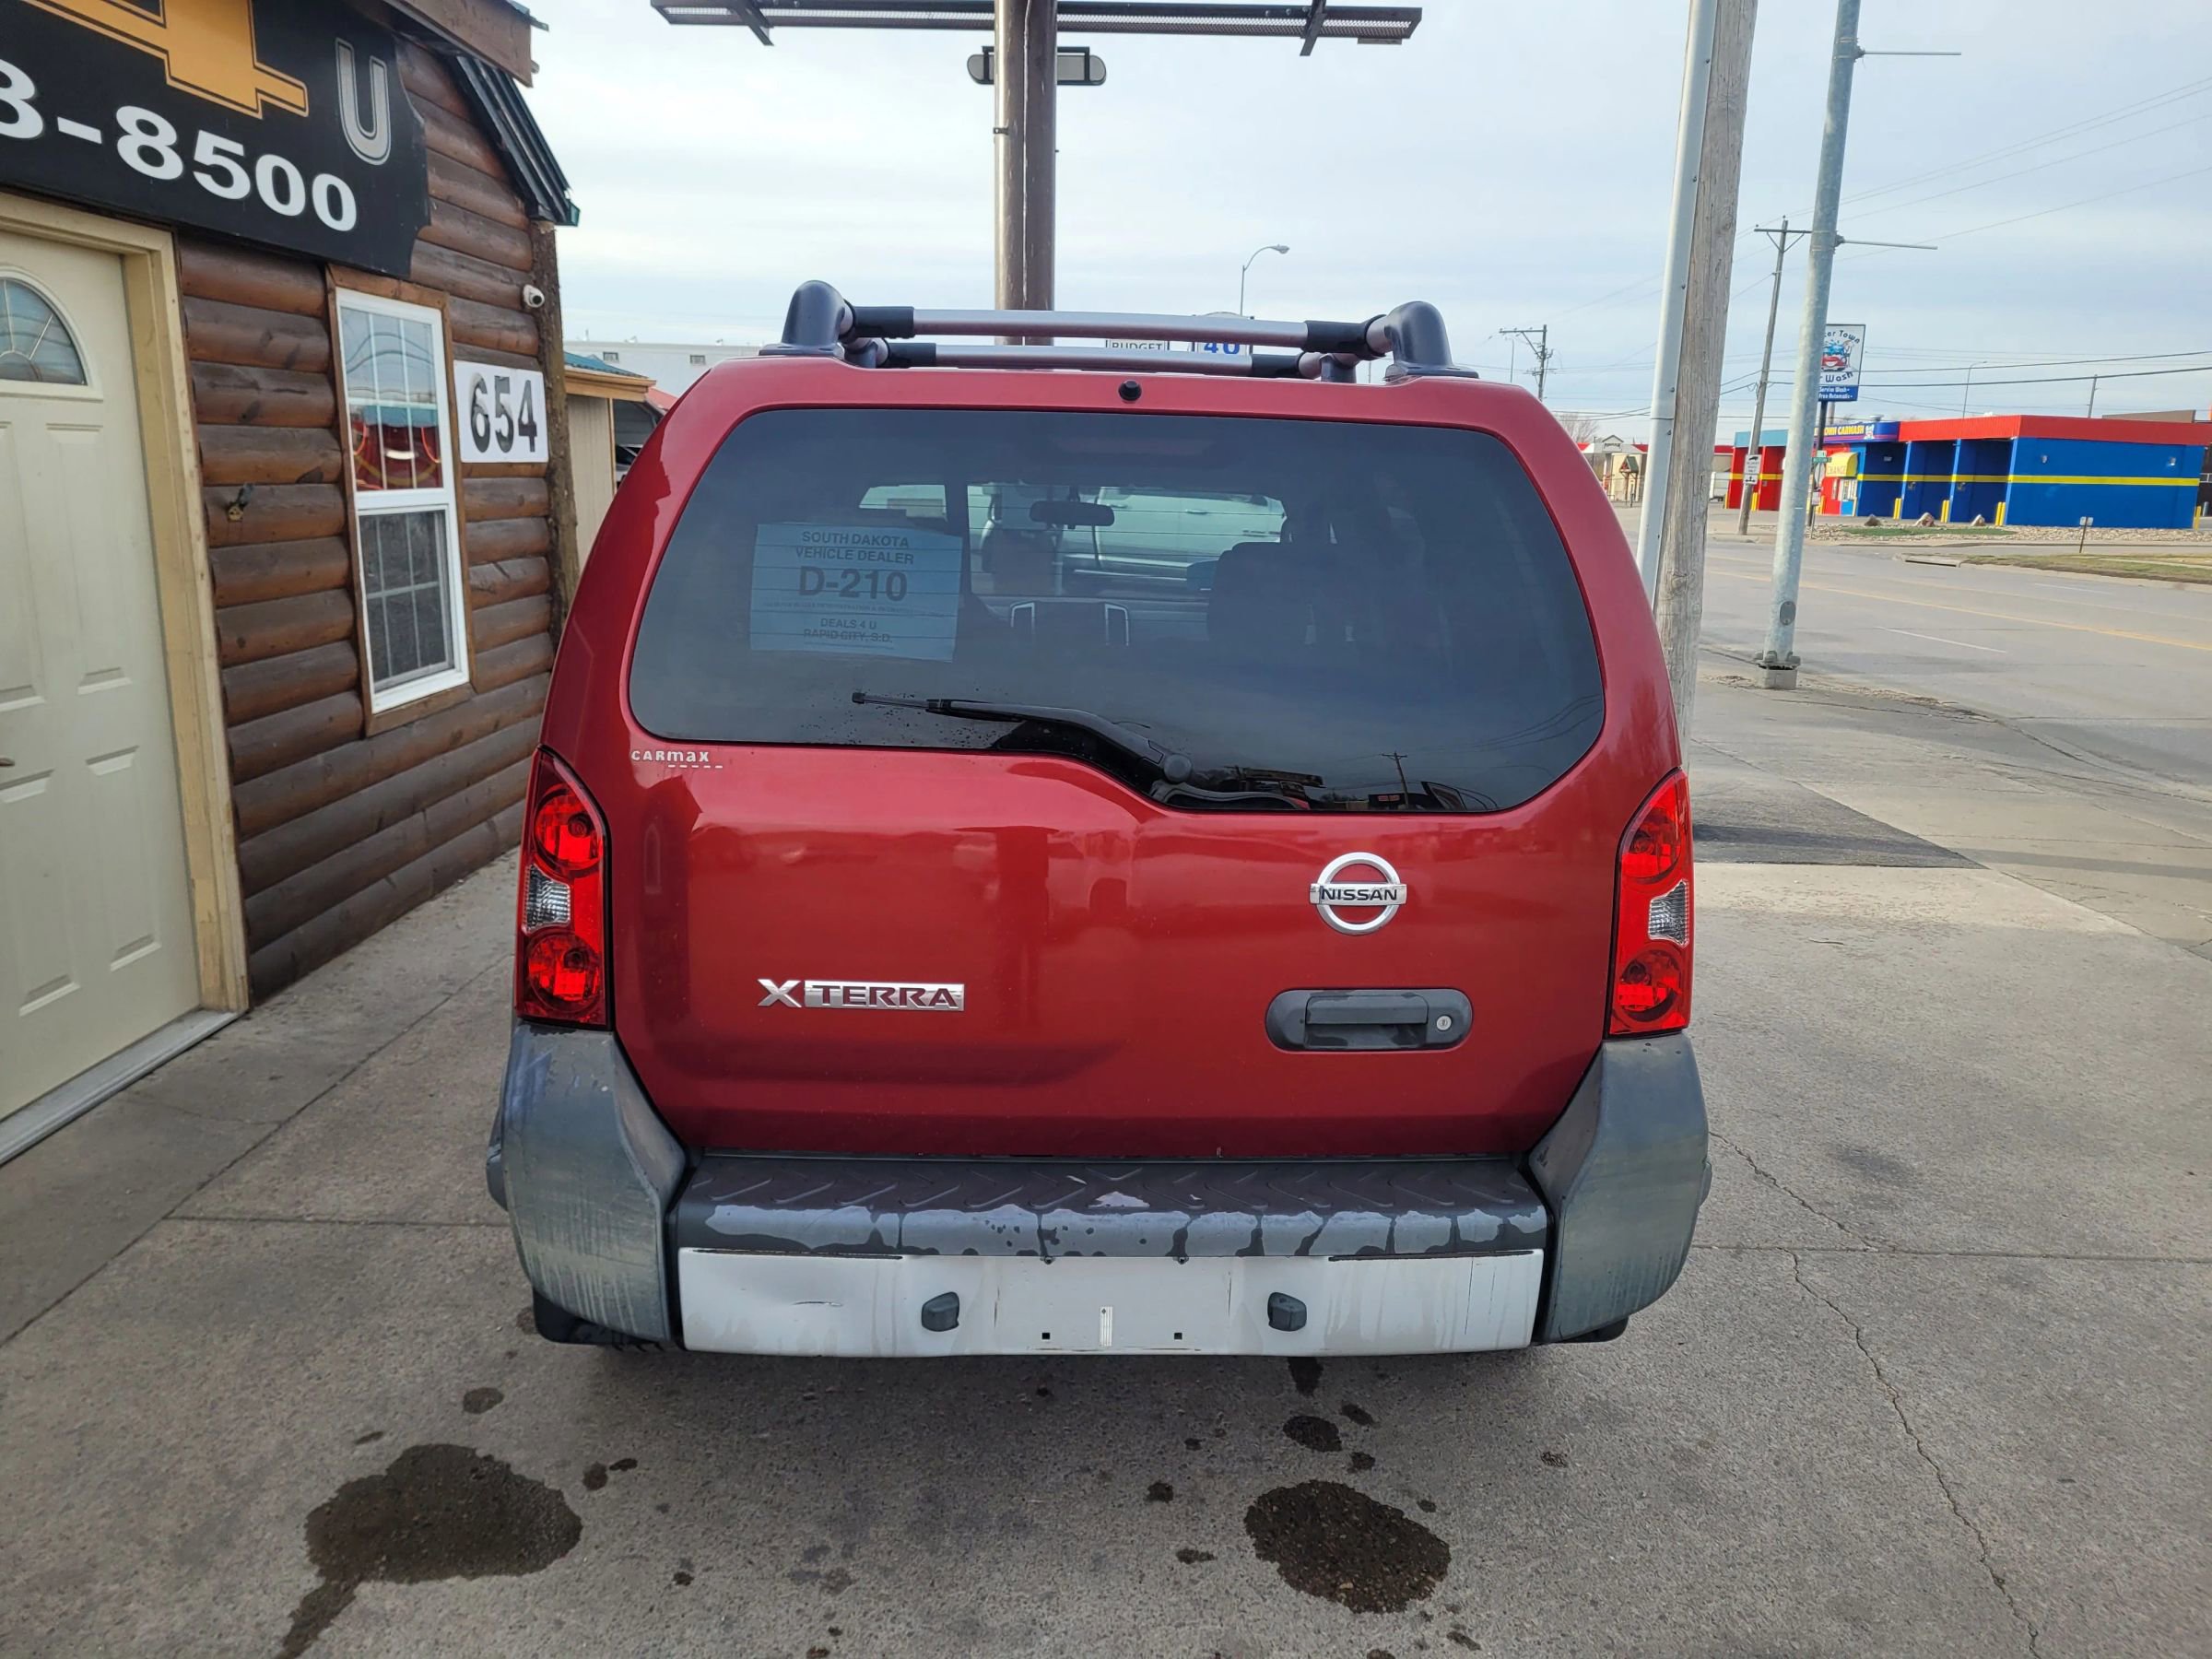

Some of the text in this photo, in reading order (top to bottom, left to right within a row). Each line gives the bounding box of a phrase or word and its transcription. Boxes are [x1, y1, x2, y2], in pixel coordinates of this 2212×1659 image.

[335, 37, 391, 166] U
[469, 372, 537, 453] 654
[802, 531, 910, 547] SOUTH DAKOTA
[795, 545, 914, 565] VEHICLE DEALER
[798, 565, 908, 602] D-210
[820, 618, 877, 629] DEALS 4 U
[804, 629, 838, 641] RAPID
[1321, 888, 1397, 901] NISSAN
